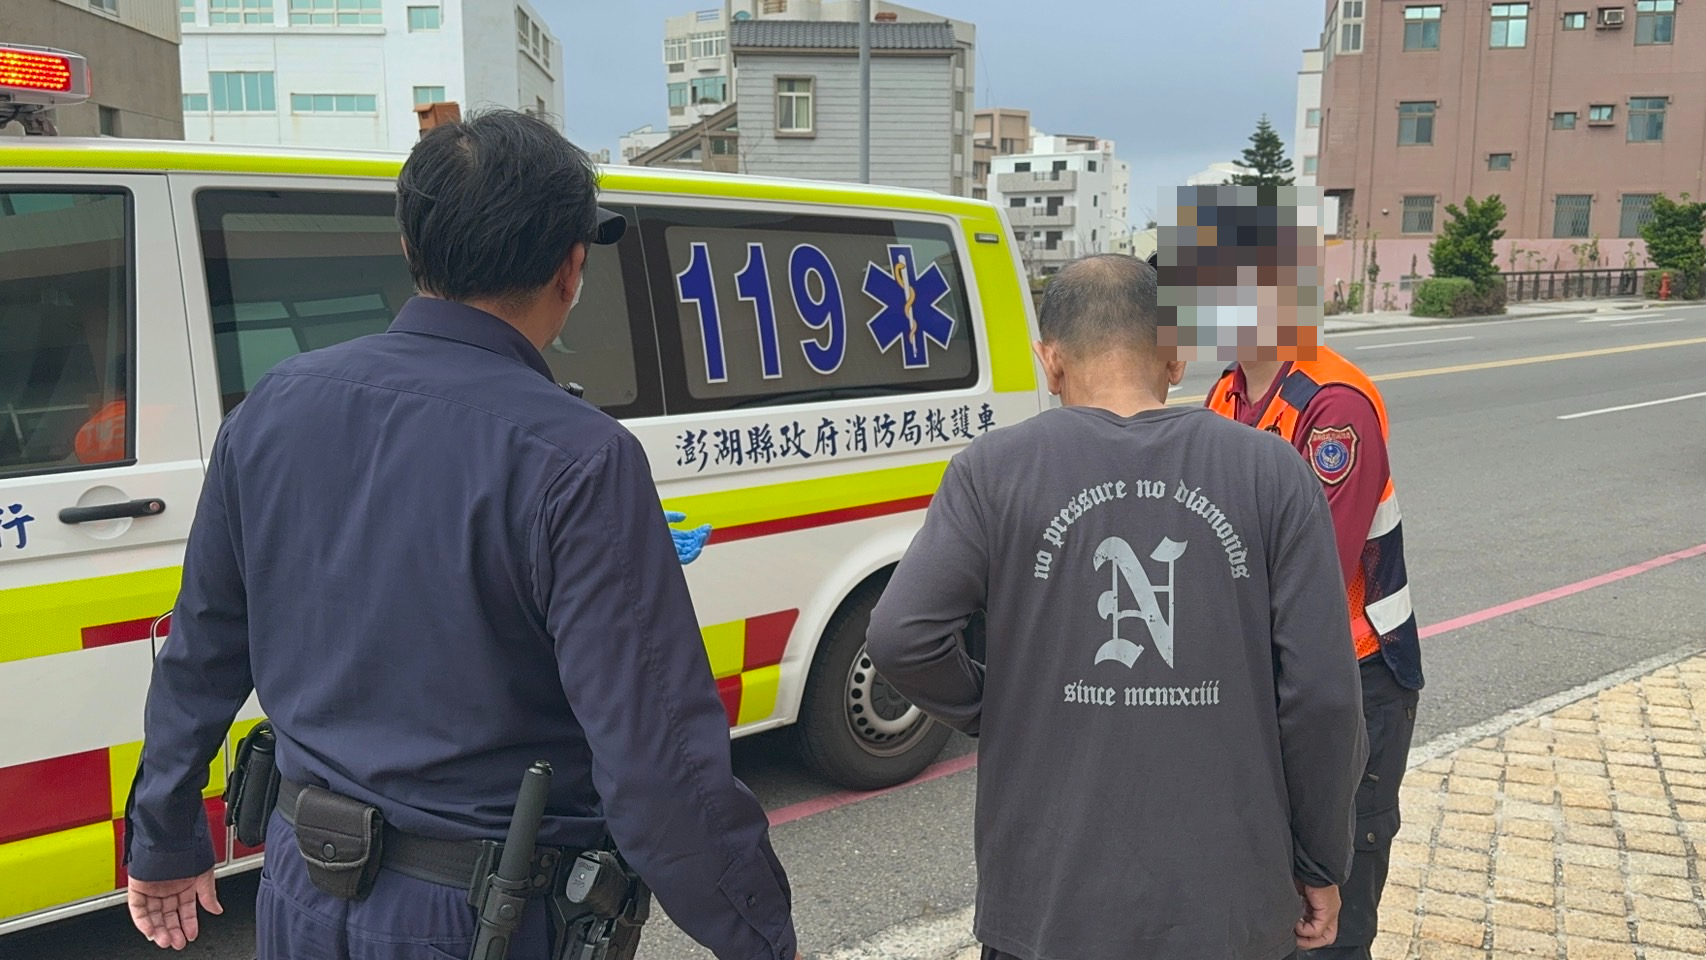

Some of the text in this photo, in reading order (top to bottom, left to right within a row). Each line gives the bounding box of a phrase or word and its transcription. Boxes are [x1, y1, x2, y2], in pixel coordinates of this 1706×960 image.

[676, 242, 846, 384] 119
[676, 402, 997, 473] 澎湖縣政府消防局救護車
[1034, 478, 1250, 580] no pressure no diamonds
[1093, 536, 1188, 669] N
[1063, 679, 1117, 706] since
